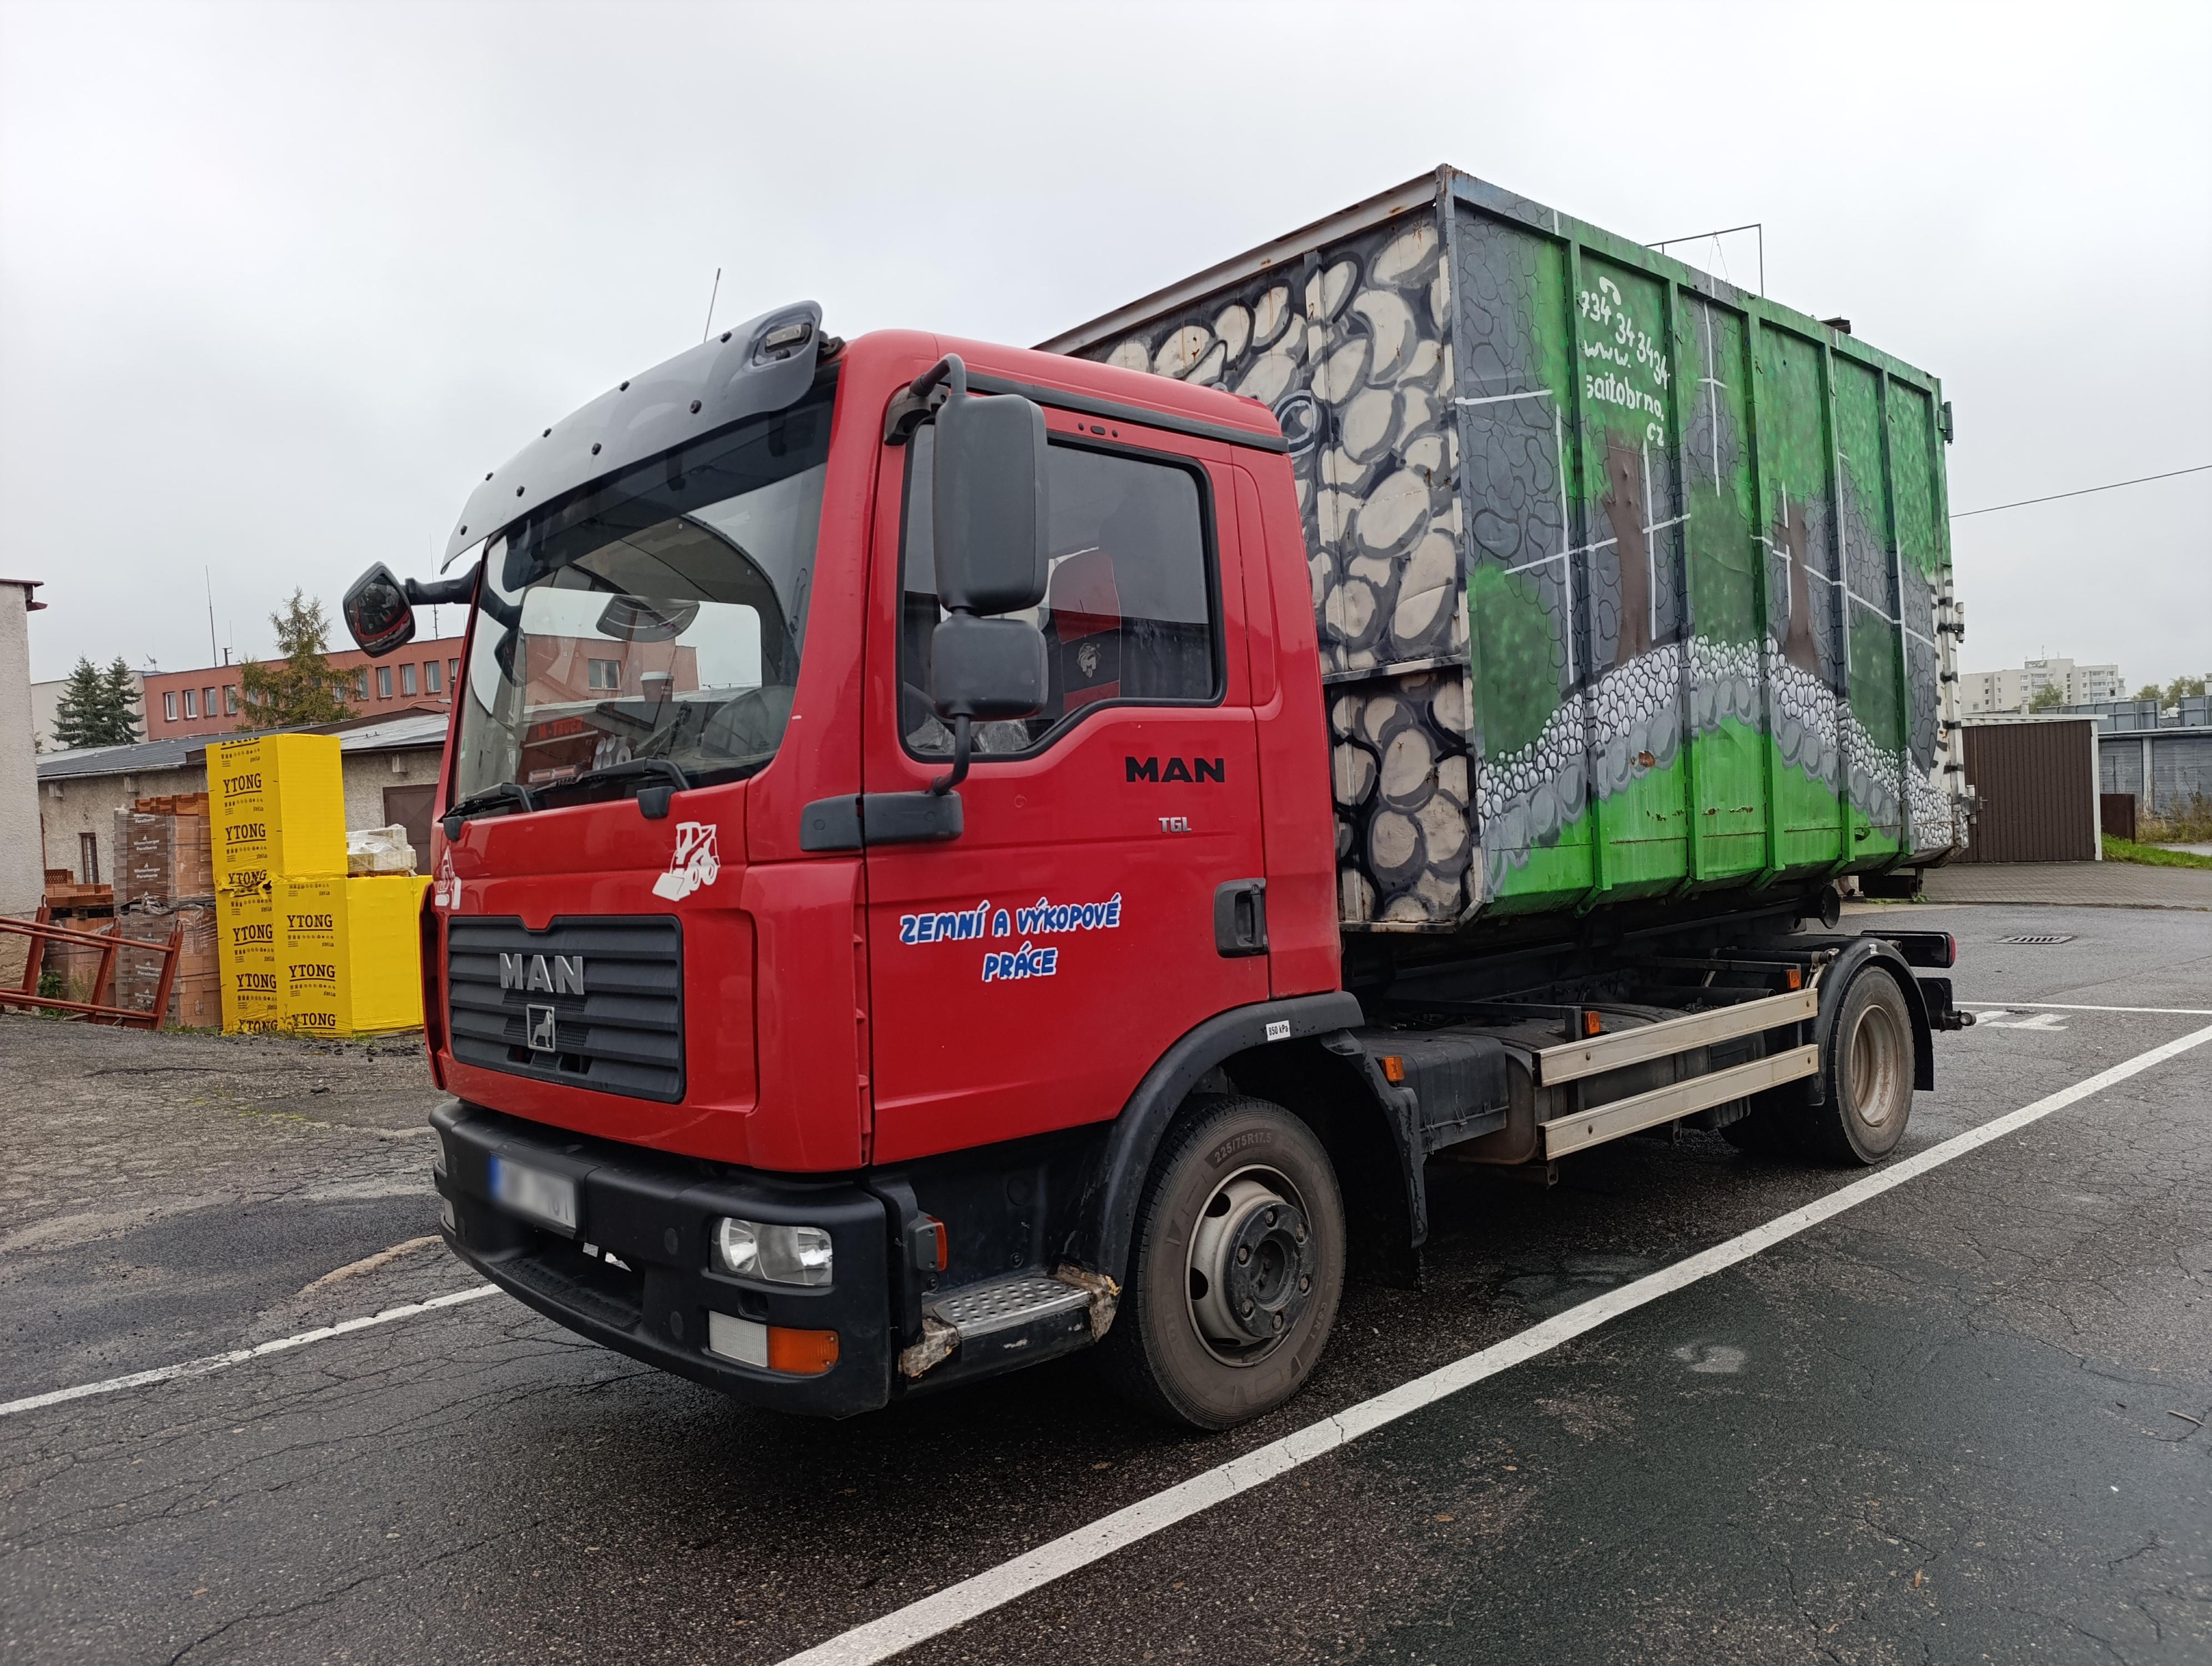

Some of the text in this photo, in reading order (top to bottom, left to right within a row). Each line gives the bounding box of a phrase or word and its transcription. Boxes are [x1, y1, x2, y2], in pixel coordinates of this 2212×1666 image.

[1582, 291, 1612, 326] 734
[1584, 339, 1631, 368] www.
[1647, 422, 1665, 446] cz
[1125, 756, 1225, 783] MAN
[223, 772, 262, 794] YTONG
[225, 823, 266, 841] YTONG
[1158, 817, 1192, 833] TGL
[228, 869, 267, 885] YTONG
[286, 914, 333, 928] YTONG
[899, 892, 1122, 945] ZEMNÍ A VÝKOPOVÉ
[233, 924, 273, 942] YTONG
[289, 964, 335, 978] YTONG
[982, 941, 1058, 982] PRÁCE
[236, 973, 276, 989] YTONG
[499, 953, 585, 995] MAN
[1269, 1024, 1288, 1036] 850 kPa
[1215, 1132, 1271, 1163] 225/75R17.5
